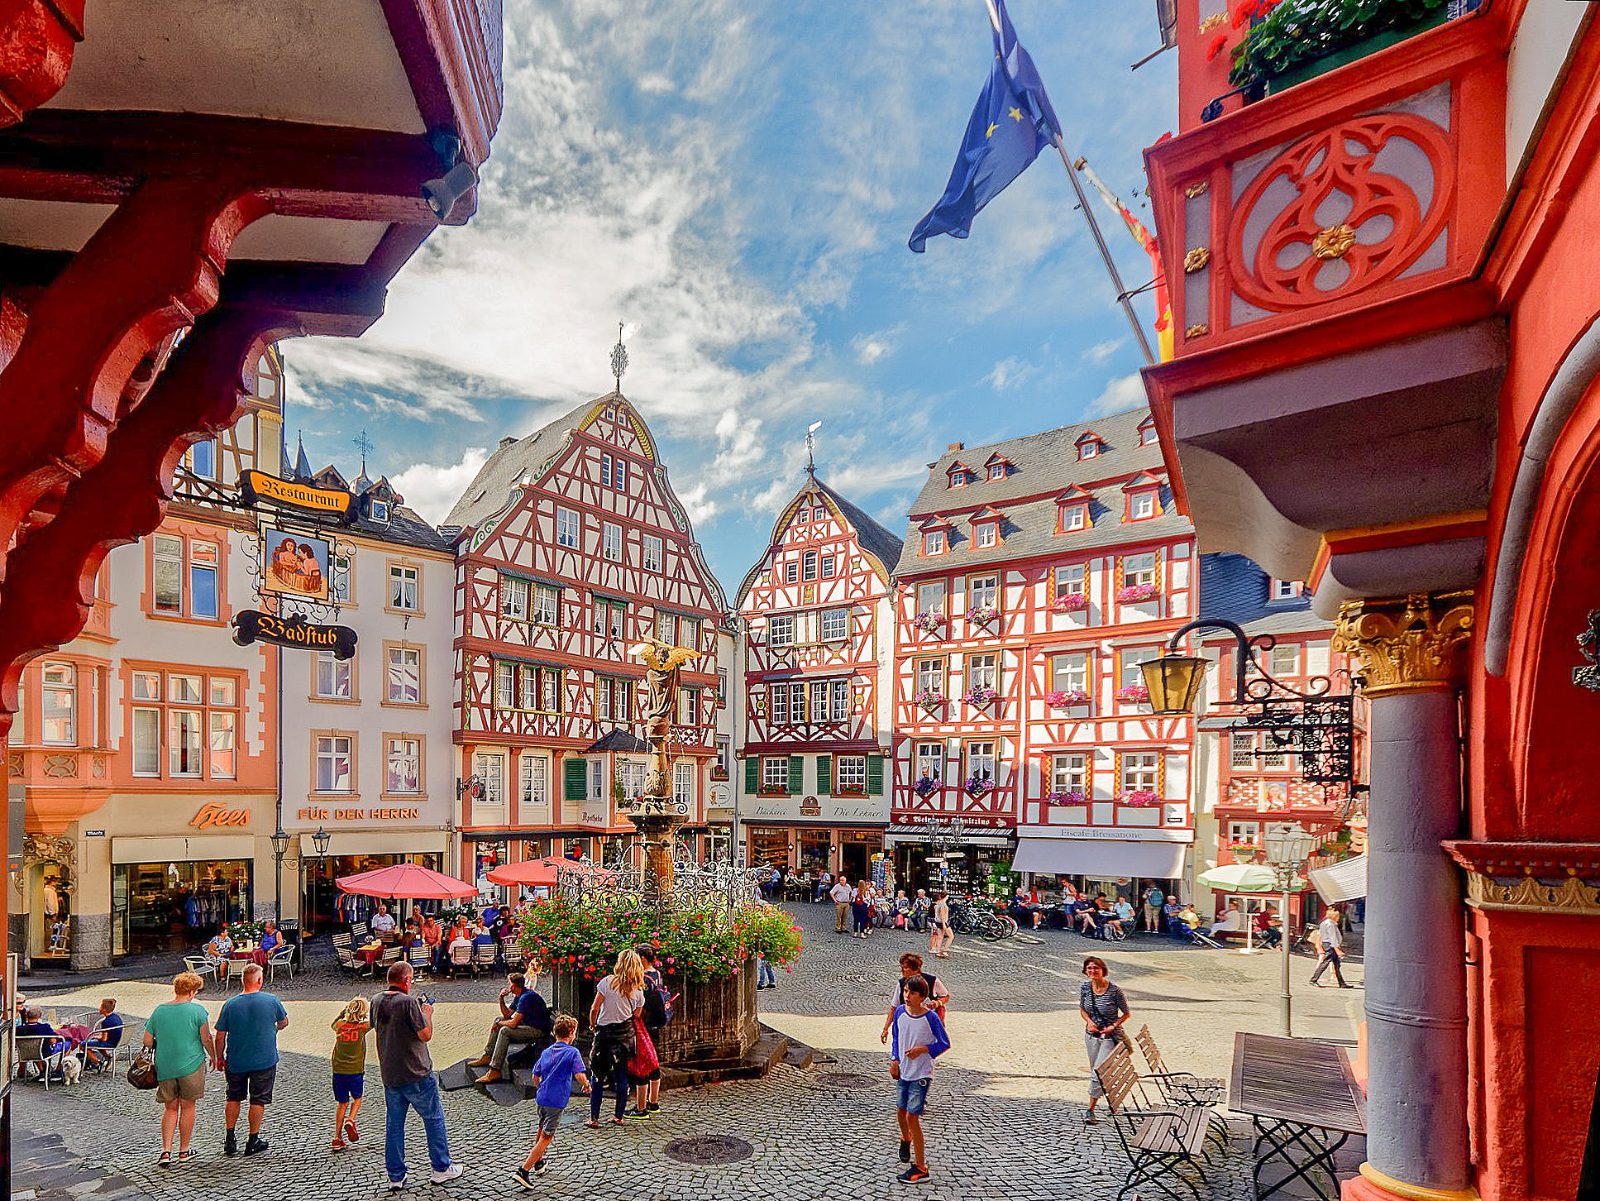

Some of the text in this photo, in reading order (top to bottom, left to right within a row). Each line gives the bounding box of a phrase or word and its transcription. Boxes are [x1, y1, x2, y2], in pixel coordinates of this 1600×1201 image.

[261, 480, 340, 508] Restaurant
[188, 801, 250, 830] Hees
[298, 806, 419, 820] FÜR DEN HERRN
[833, 807, 849, 816] Die
